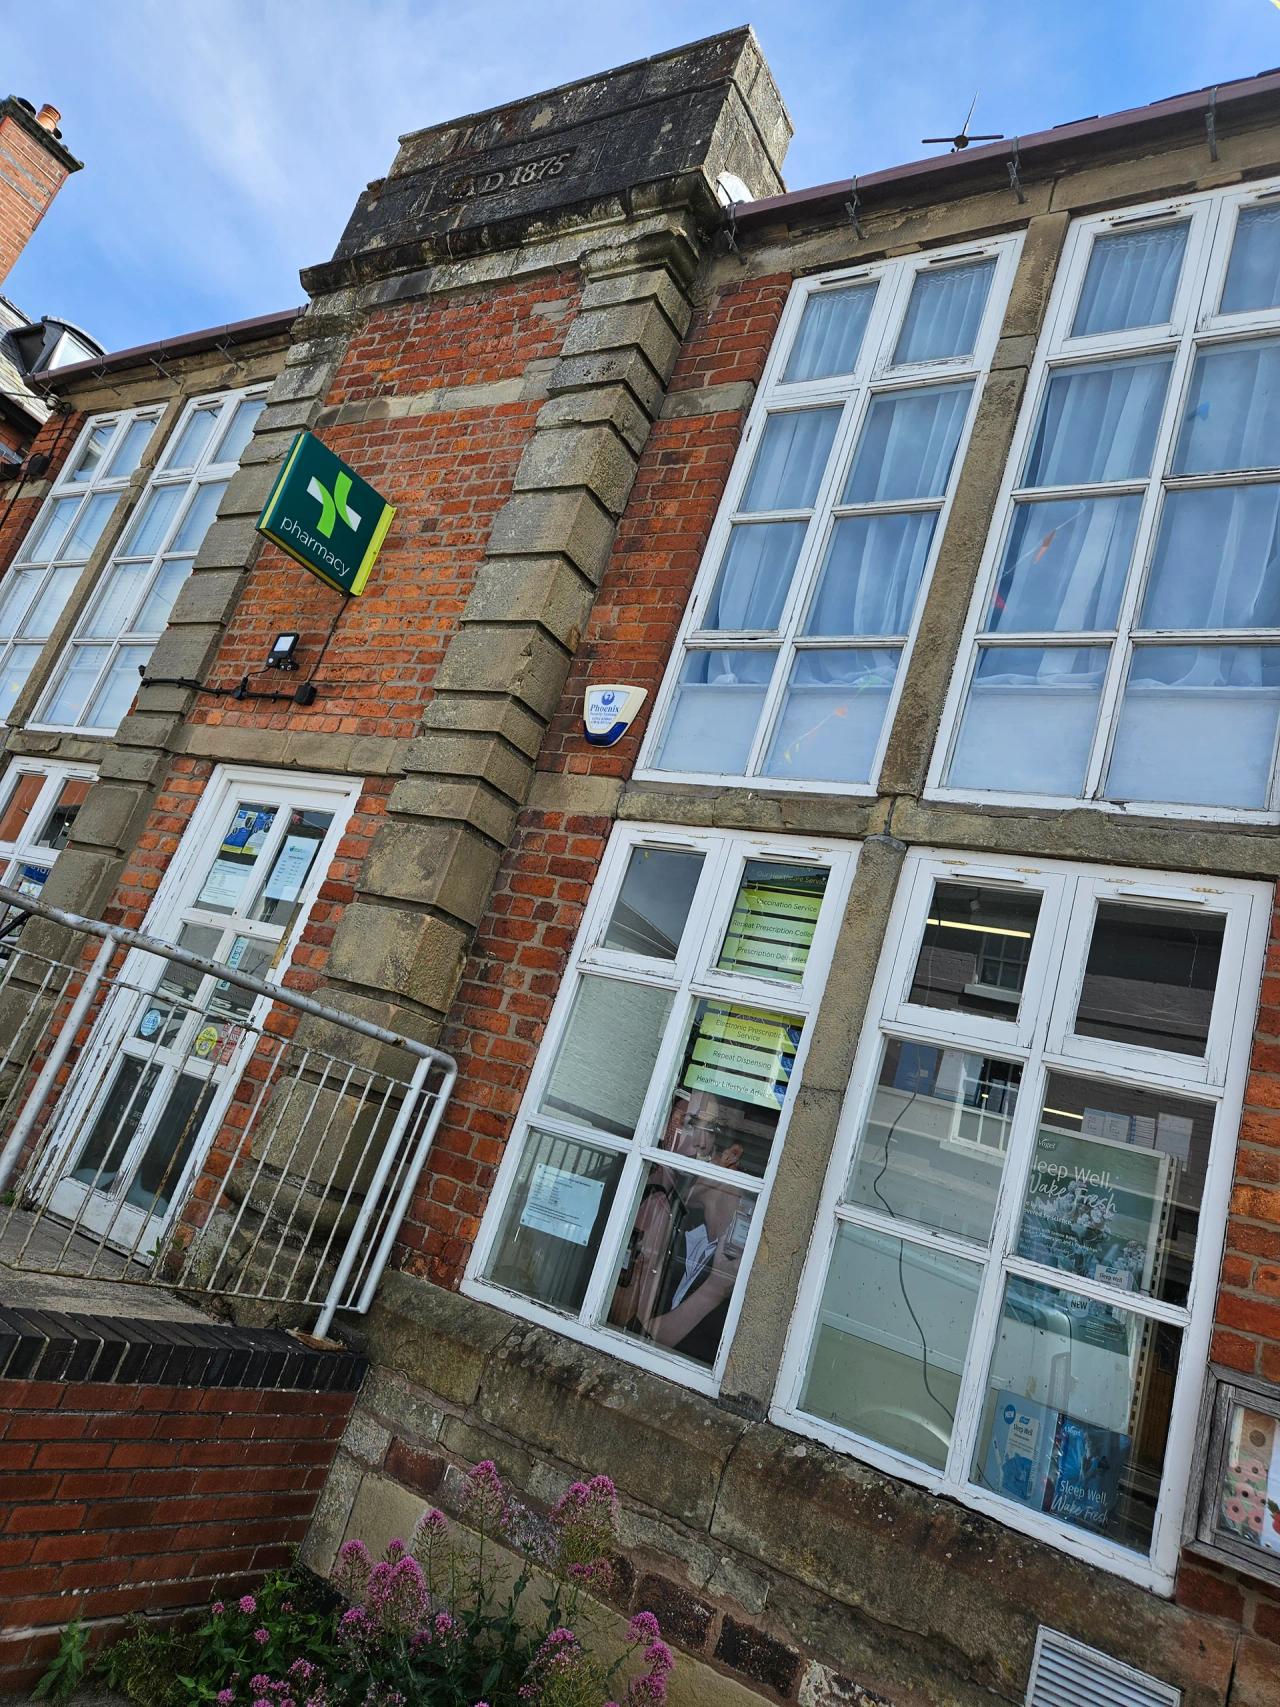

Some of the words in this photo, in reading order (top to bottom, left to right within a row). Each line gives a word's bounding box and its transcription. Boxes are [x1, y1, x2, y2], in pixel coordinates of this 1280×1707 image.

[509, 153, 571, 187] 1875
[280, 516, 351, 577] pharmacy
[590, 704, 619, 713] Phoenix
[756, 898, 792, 910] Vaccination
[793, 903, 818, 913] Service
[732, 920, 755, 931] Repeat
[755, 924, 794, 936] Prescription
[737, 947, 775, 960] Prescription
[715, 1019, 747, 1032] Electronic
[747, 1026, 787, 1041] Prescription
[737, 1031, 761, 1042] Service
[713, 1050, 735, 1062] Repeat
[736, 1055, 772, 1071] Dispensing
[696, 1075, 720, 1088] Healthy
[722, 1081, 749, 1093] Lifestyle
[1033, 1154, 1068, 1181] leep
[1074, 1166, 1113, 1193] Well,
[1070, 1187, 1118, 1216] Fresh
[1071, 1300, 1088, 1311] NEW
[1059, 1480, 1085, 1498] Sleep
[1087, 1489, 1108, 1507] Well,
[1051, 1494, 1083, 1515] Wake
[1084, 1506, 1109, 1526] Fresh
